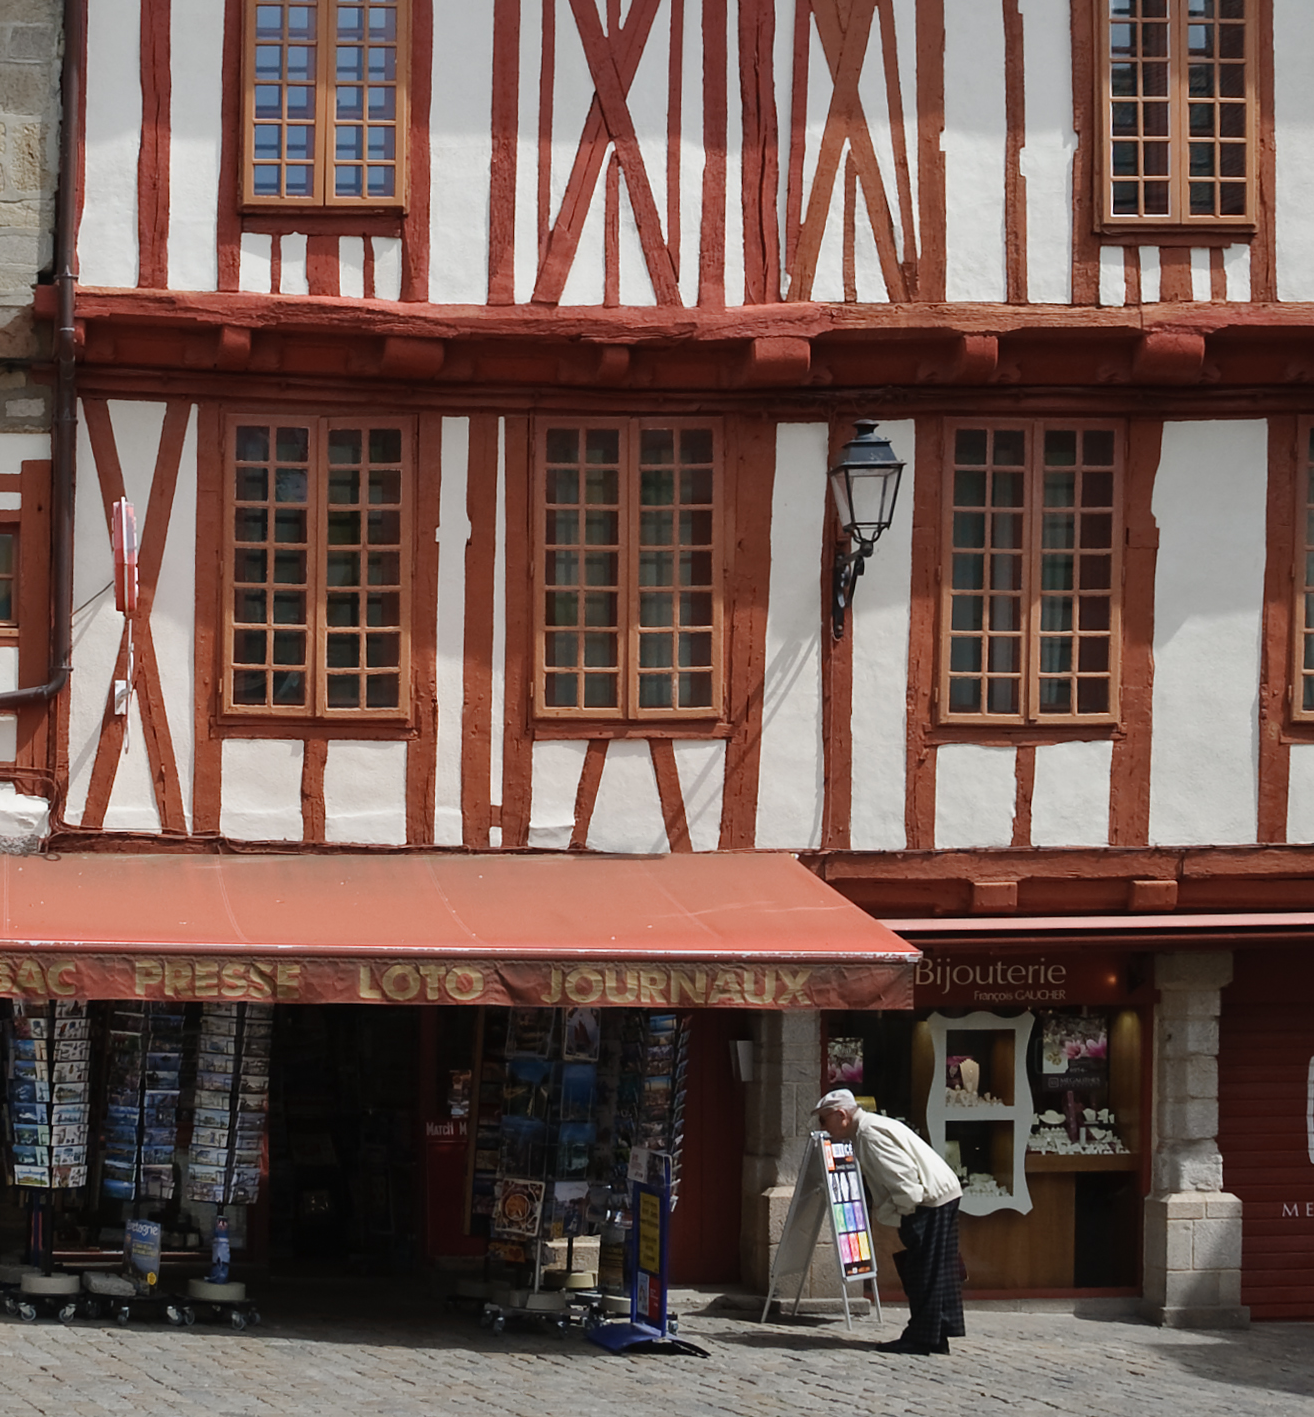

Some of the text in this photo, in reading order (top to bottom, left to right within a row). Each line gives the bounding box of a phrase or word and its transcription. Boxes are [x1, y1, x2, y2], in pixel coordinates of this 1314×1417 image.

[134, 959, 302, 999] PRESSE
[359, 964, 485, 1001] LOTO
[541, 967, 813, 1006] JOURNAUX
[915, 957, 1067, 995] Bijouterie
[973, 989, 1067, 1003] François GAUCHER
